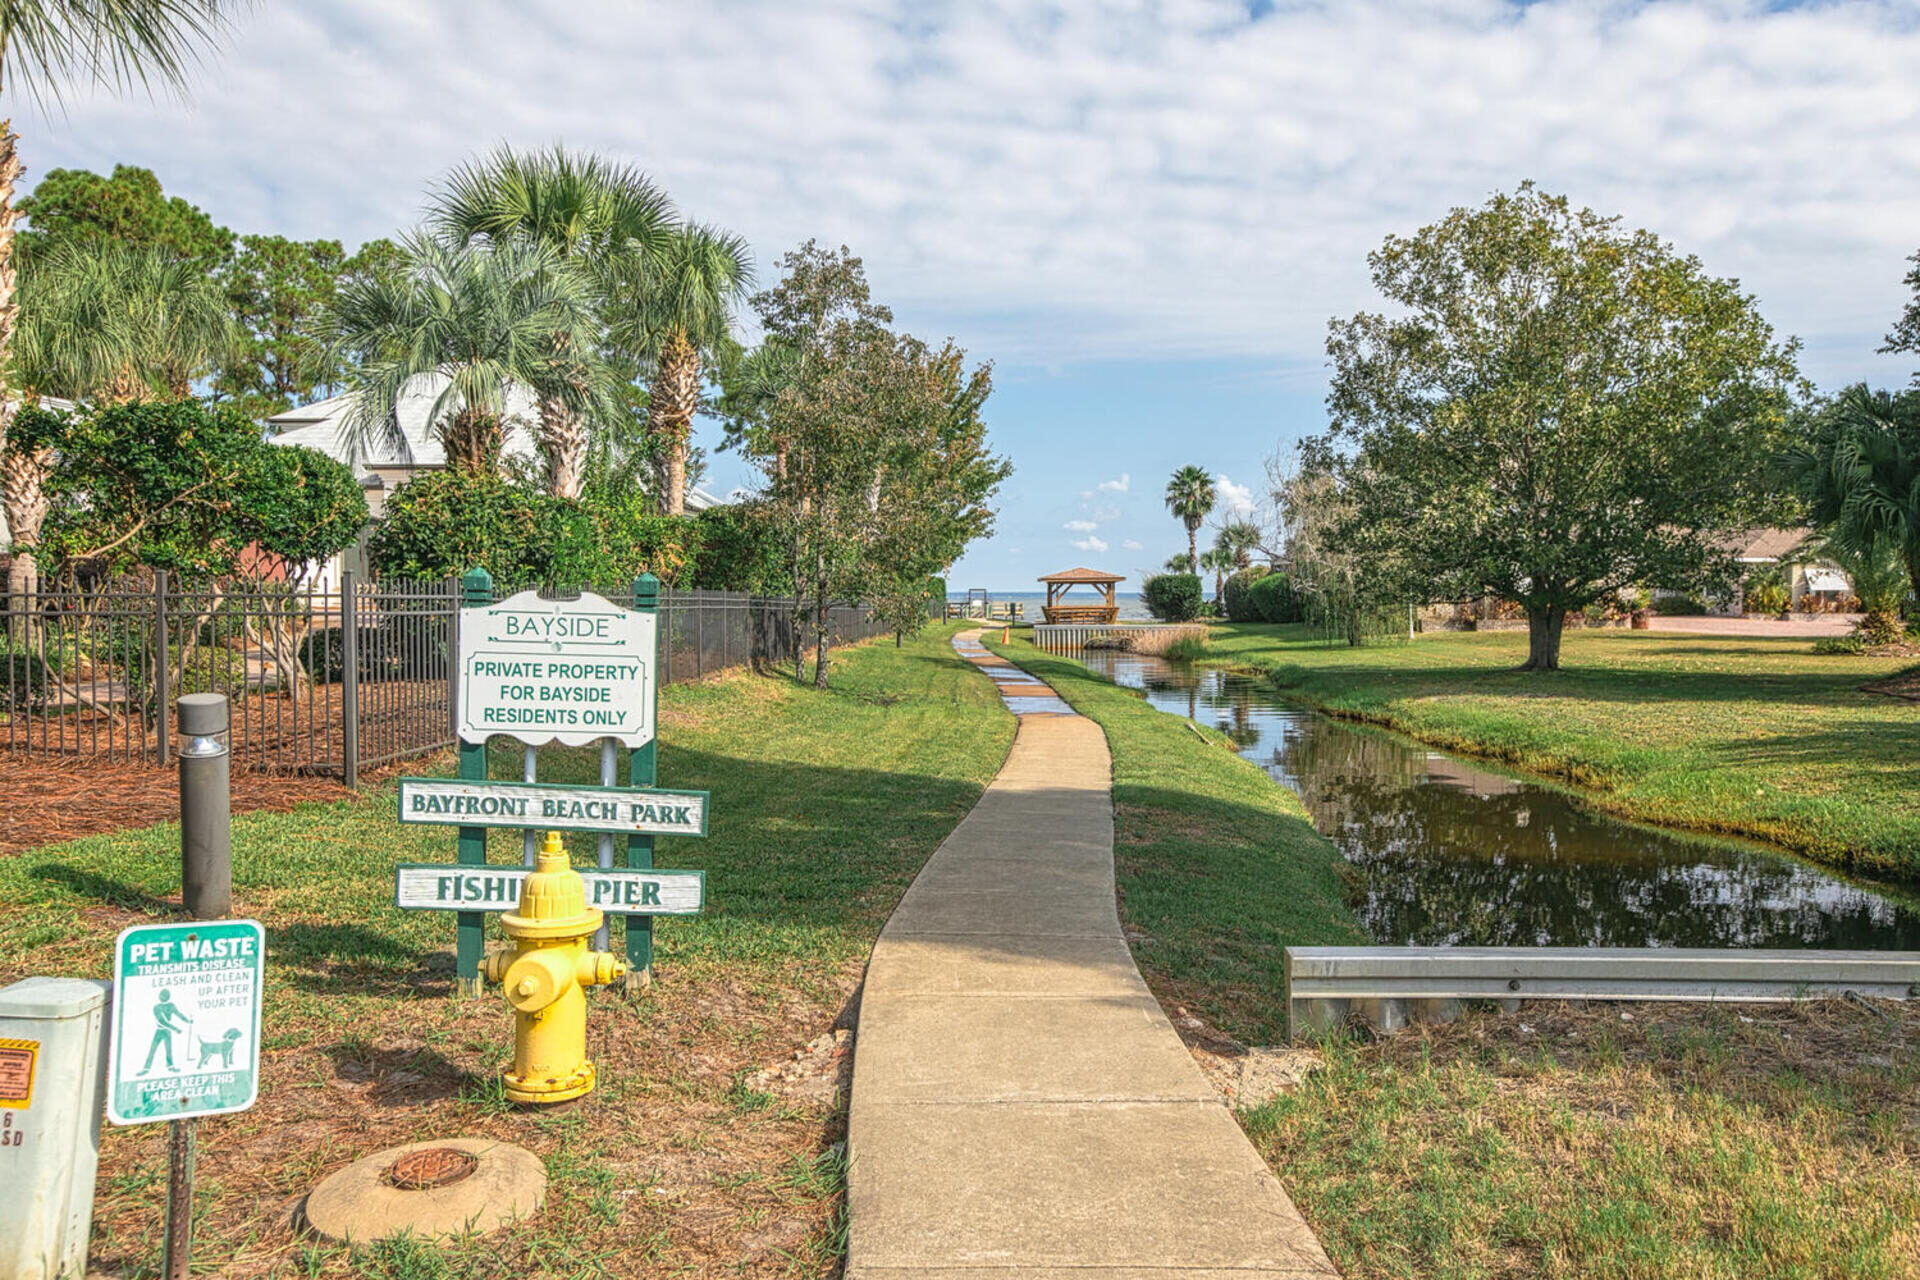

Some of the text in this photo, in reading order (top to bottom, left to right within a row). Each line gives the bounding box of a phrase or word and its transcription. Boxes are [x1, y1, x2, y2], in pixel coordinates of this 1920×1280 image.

[506, 616, 609, 637] BAYSIDE
[474, 661, 639, 681] PRIVATE PROPERTY
[500, 685, 611, 702] FOR BAYSIDE
[483, 707, 628, 726] RESIDENTS ONLY
[411, 793, 693, 825] BAYFRONT BEACH PARK
[436, 873, 663, 906] FISHI PIER
[130, 937, 255, 963] PET WASTE
[138, 958, 246, 976] TRANSMITS DISEASE
[152, 972, 250, 988] LEASH AND CLEAN
[198, 984, 249, 997] UP AFTER
[198, 996, 249, 1010] YOUR PET
[136, 1072, 236, 1093] PLEASE KEEP THIS
[152, 1085, 220, 1102] AREA CLEAN
[3, 1111, 13, 1128] 6
